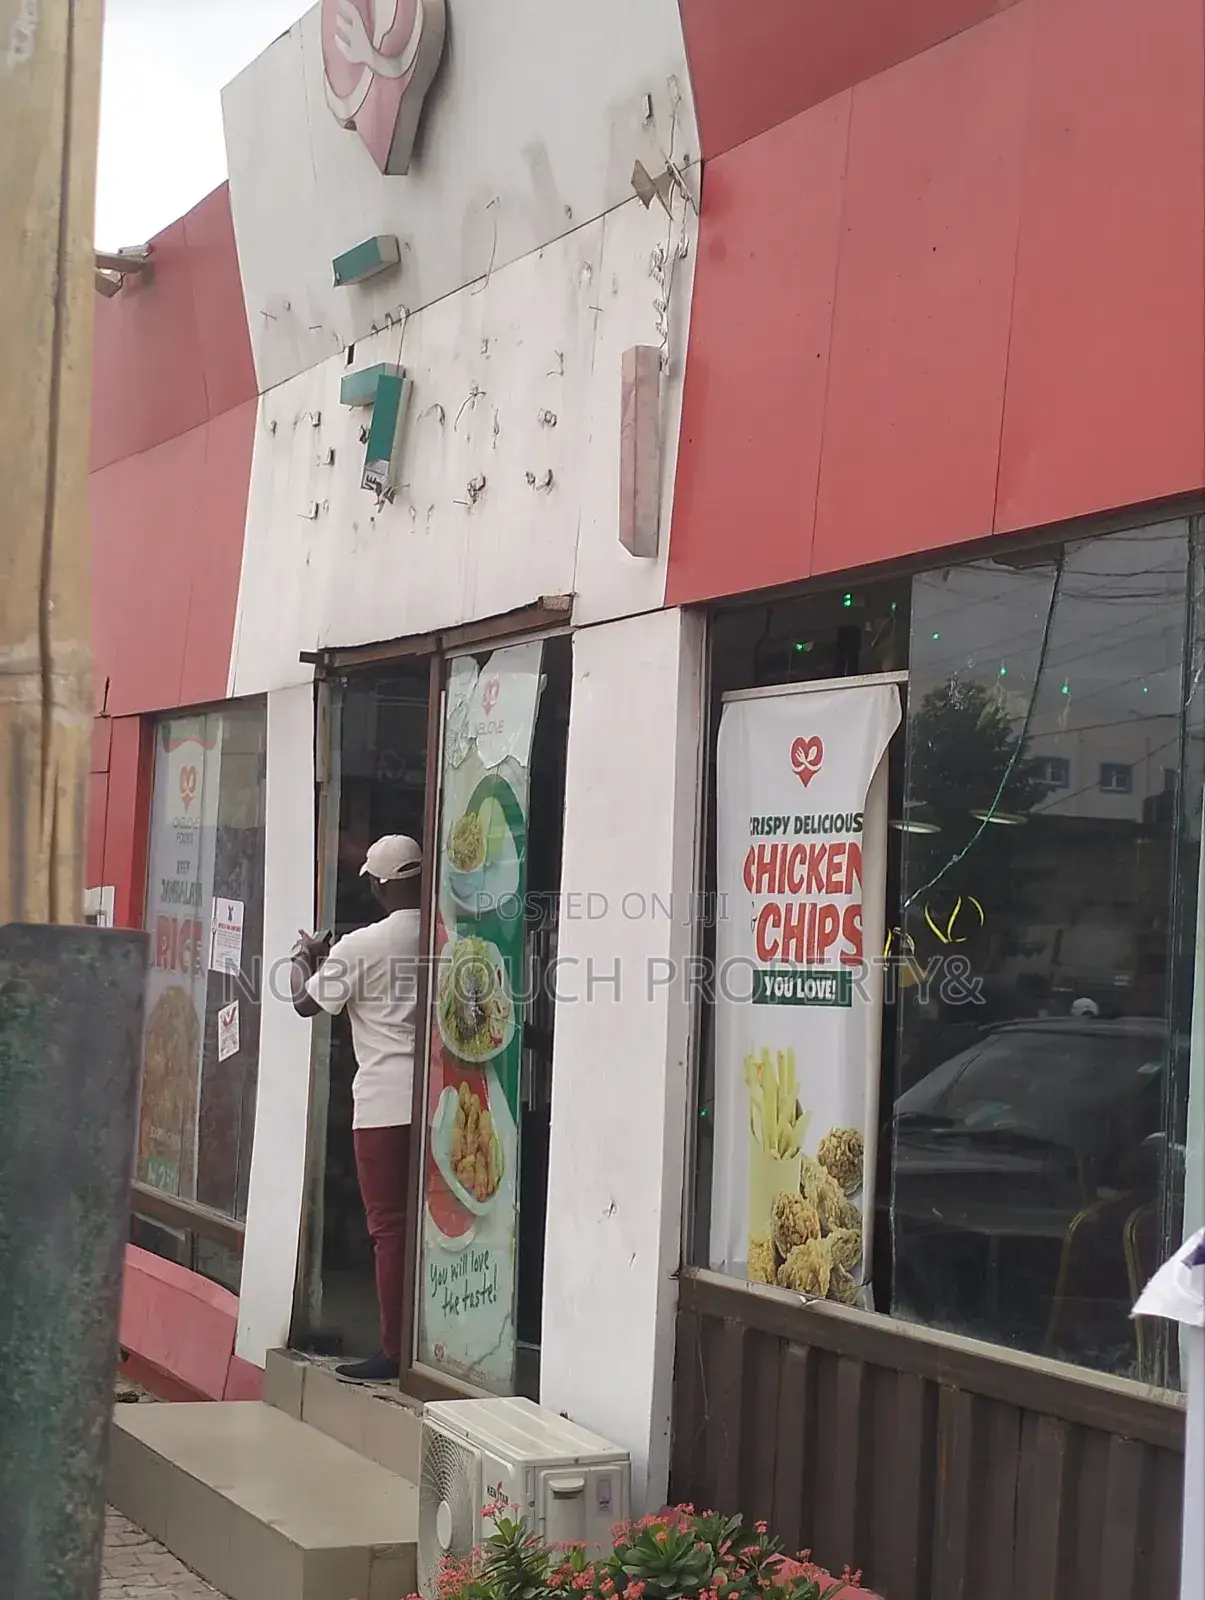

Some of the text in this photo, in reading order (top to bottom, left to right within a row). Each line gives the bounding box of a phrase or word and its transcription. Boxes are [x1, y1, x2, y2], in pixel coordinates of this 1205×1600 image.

[794, 812, 864, 835] DELICIOUS
[756, 901, 863, 966] CHIPS
[764, 975, 836, 1000] YOU LOVE!
[450, 1252, 468, 1283] will
[471, 1249, 490, 1274] love
[442, 1286, 460, 1318] the
